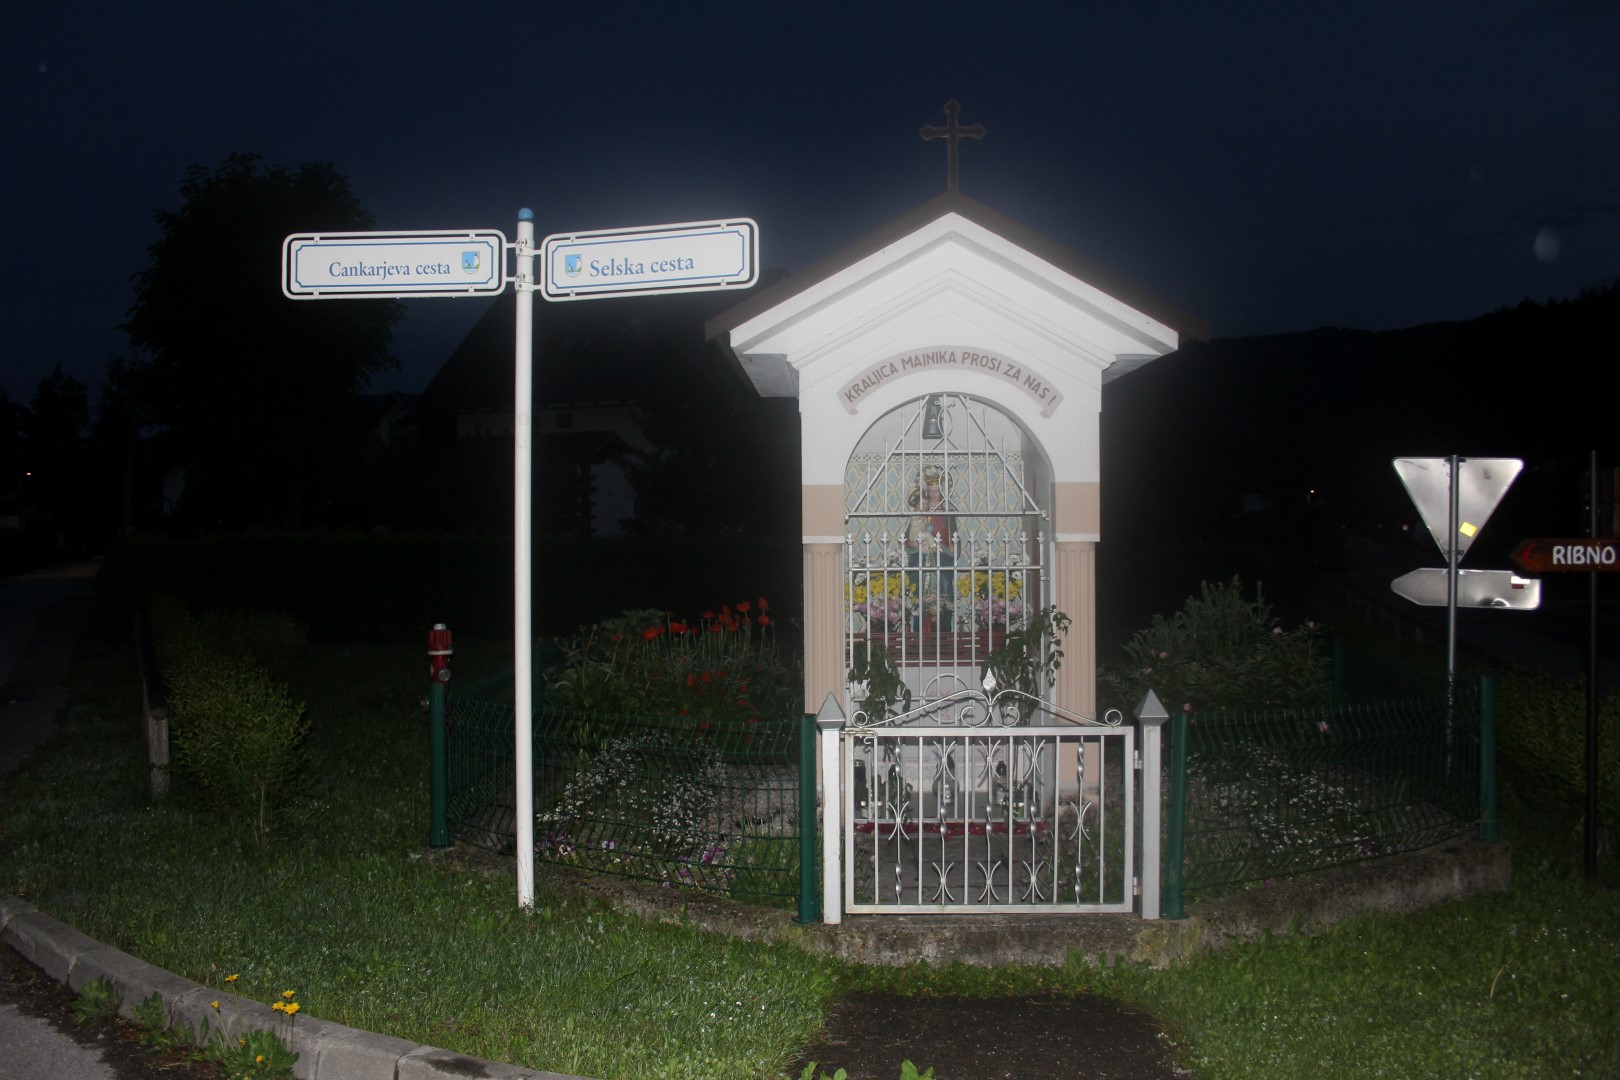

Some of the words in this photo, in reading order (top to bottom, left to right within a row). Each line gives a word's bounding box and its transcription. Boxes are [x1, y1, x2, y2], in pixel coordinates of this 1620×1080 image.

[329, 261, 410, 280] Cankarjeva
[416, 262, 451, 275] cesta
[589, 258, 645, 277] Selska
[650, 257, 695, 273] cesta
[845, 362, 898, 402] KRALJICA
[901, 351, 957, 370] MAJNIKA
[961, 352, 1002, 372] PROSI
[1003, 363, 1021, 382] ZA
[1552, 545, 1616, 565] RIBNO
